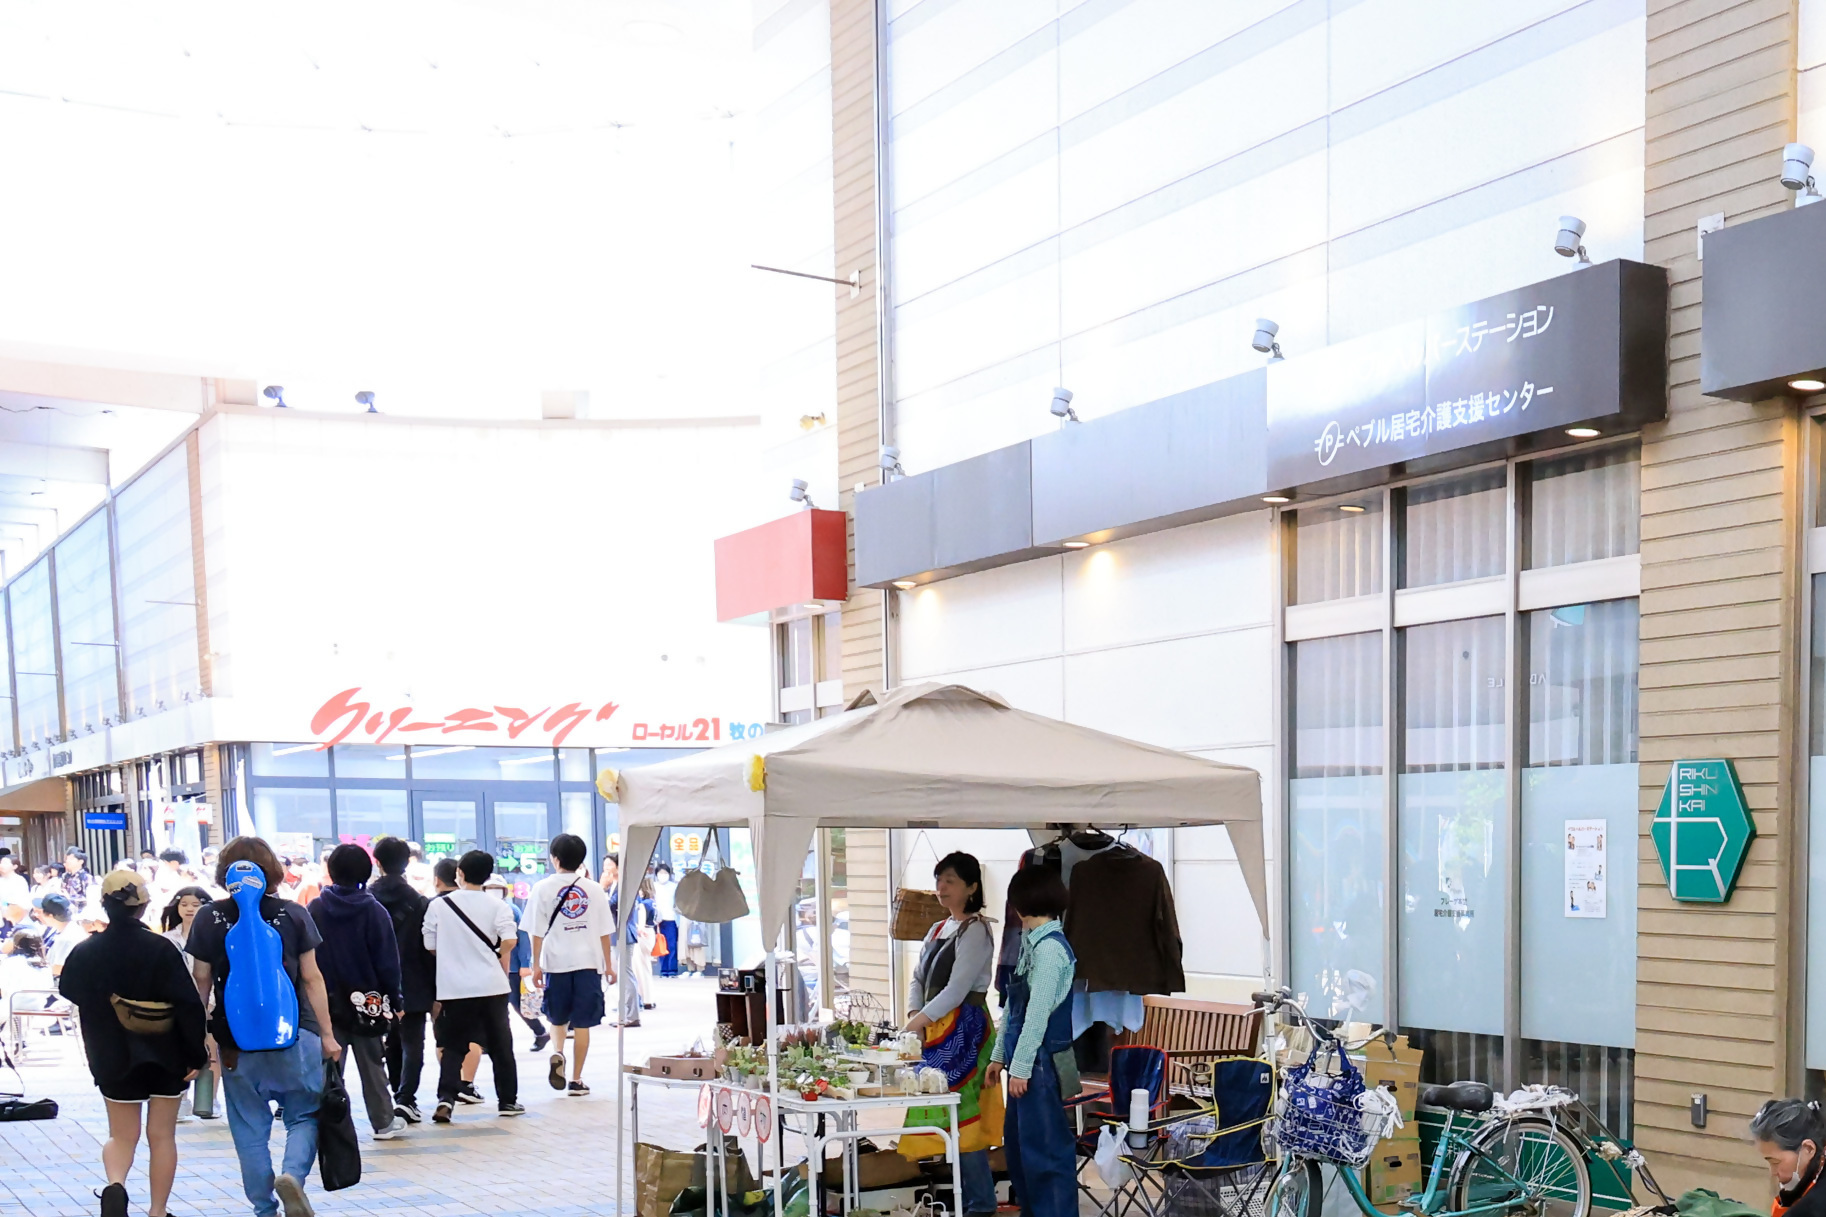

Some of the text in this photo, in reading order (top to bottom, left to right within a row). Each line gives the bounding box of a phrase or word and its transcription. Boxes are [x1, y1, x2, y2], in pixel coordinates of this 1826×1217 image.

[1345, 380, 1554, 449] ペブル居宅介護支援センター
[309, 686, 620, 753] クリーニング
[1679, 799, 1706, 812] KAI
